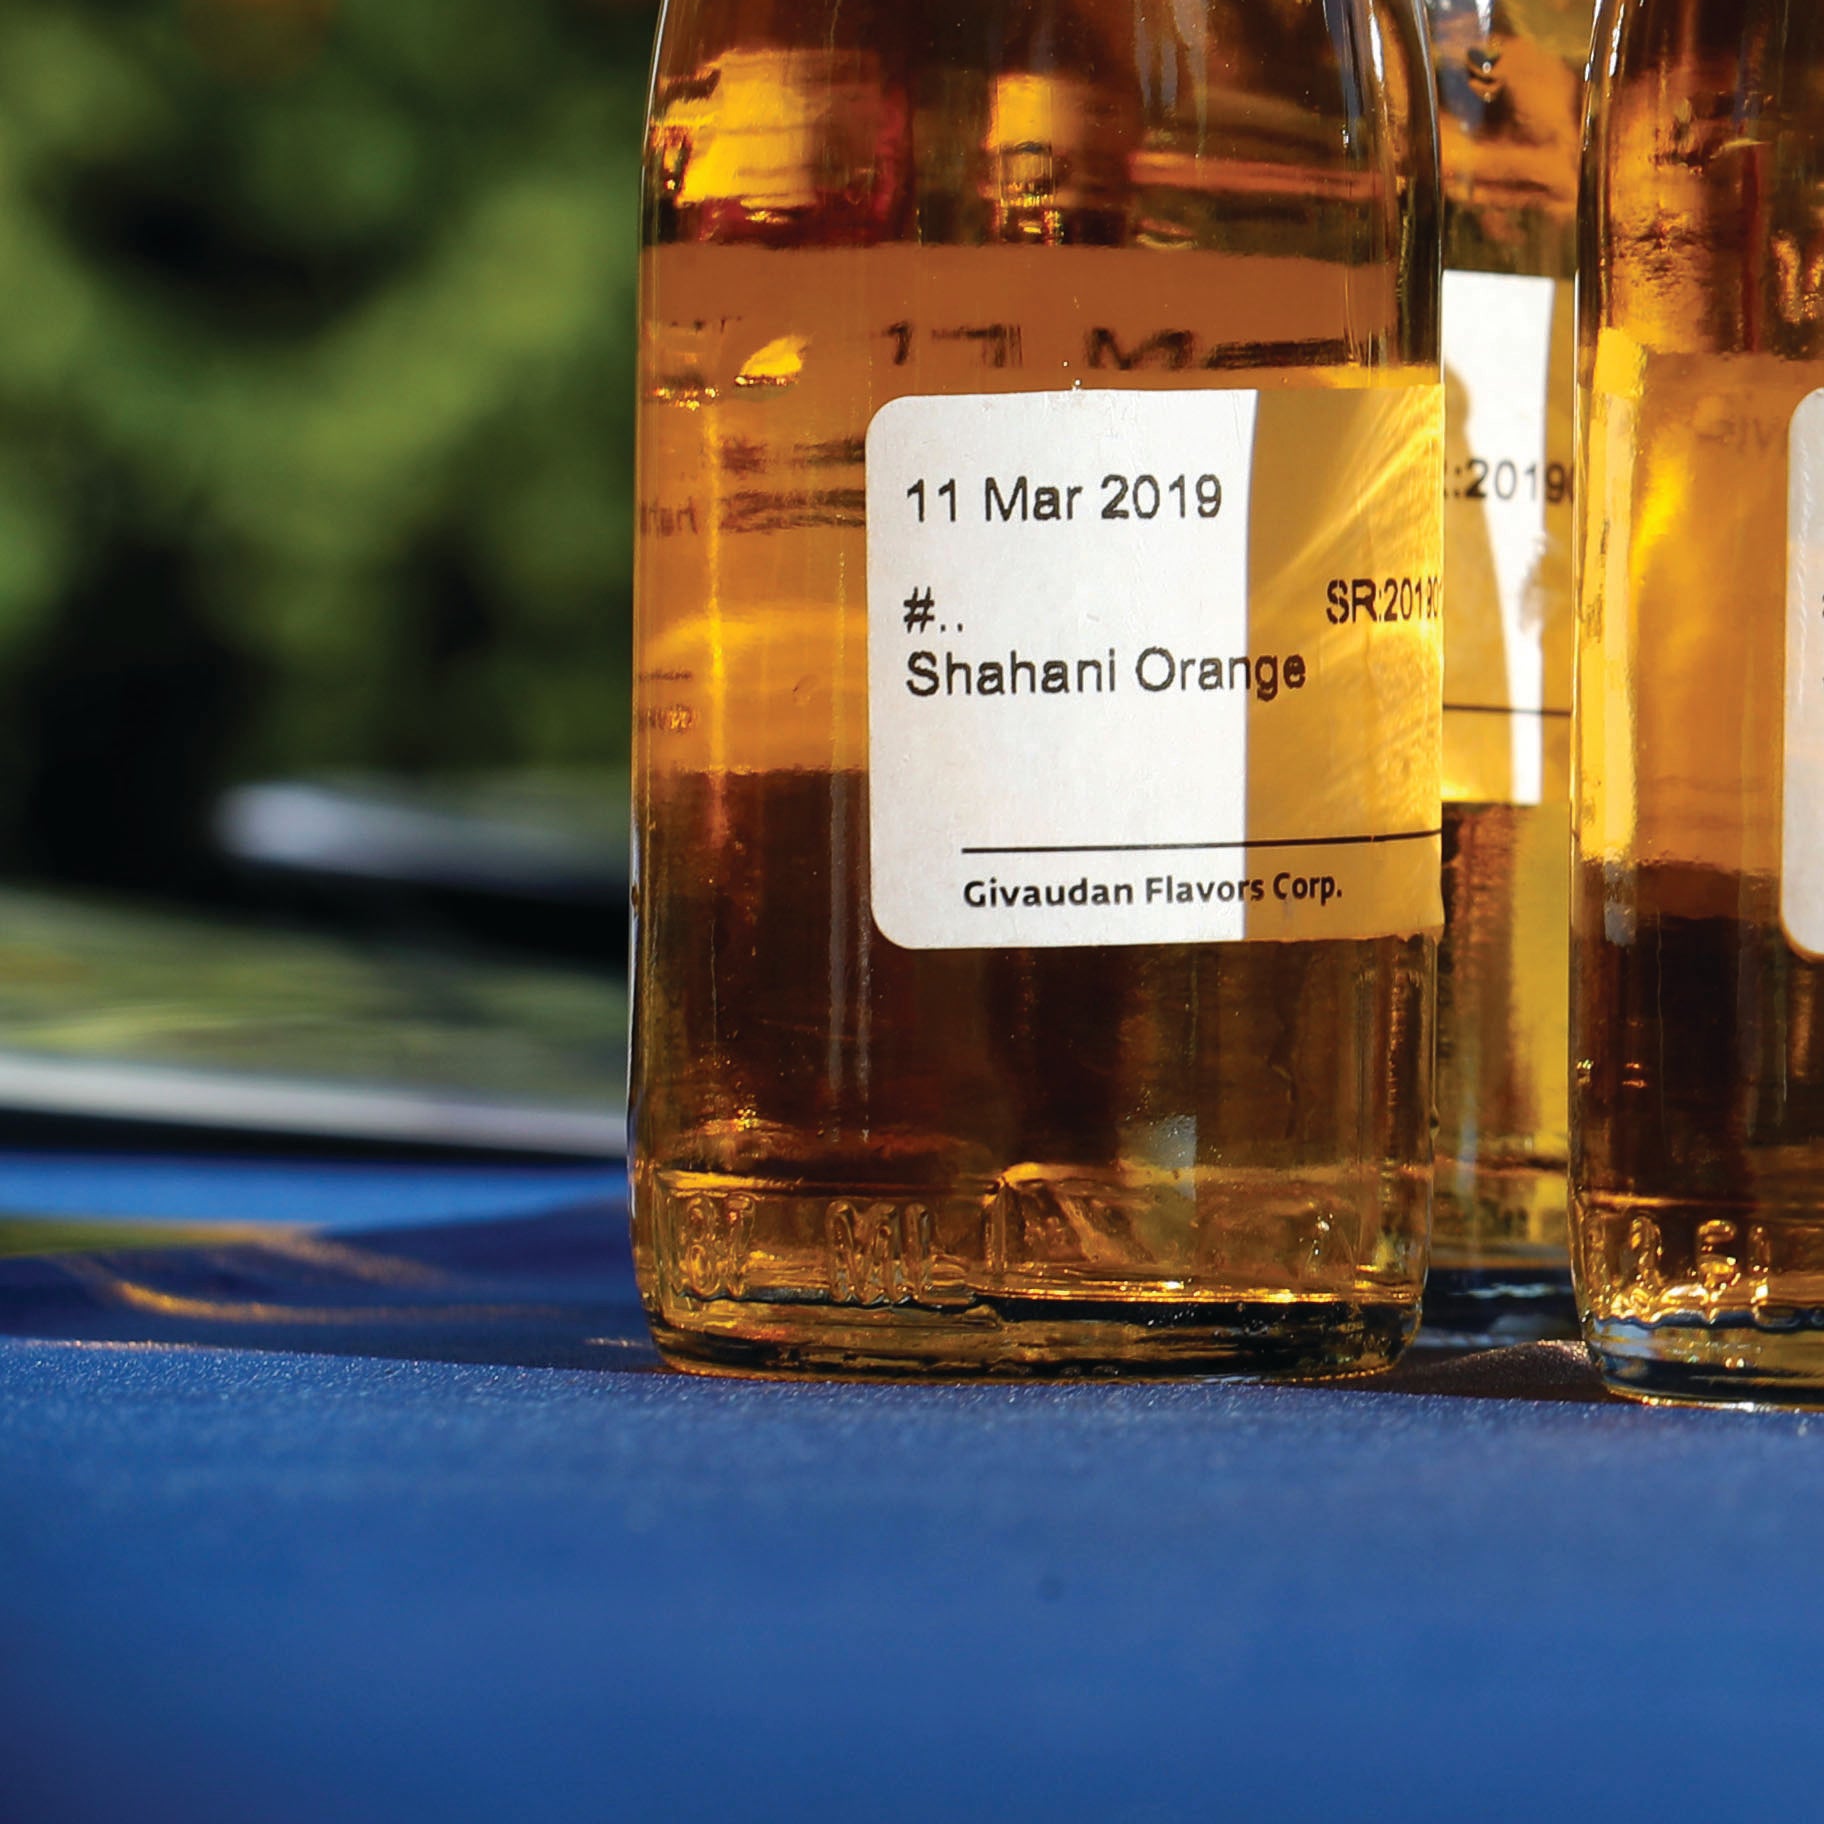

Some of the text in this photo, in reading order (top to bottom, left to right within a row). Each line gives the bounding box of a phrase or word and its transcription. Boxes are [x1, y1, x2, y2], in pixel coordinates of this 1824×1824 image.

[904, 477, 958, 524] 11
[983, 474, 1085, 524] Mar
[1099, 472, 1223, 521] 2019
[1444, 458, 1574, 506] :2019
[1325, 576, 1442, 625] SR:20190
[904, 645, 1307, 703] Shahani Orange
[963, 870, 1344, 908] Givaudan Flavors Corp.
